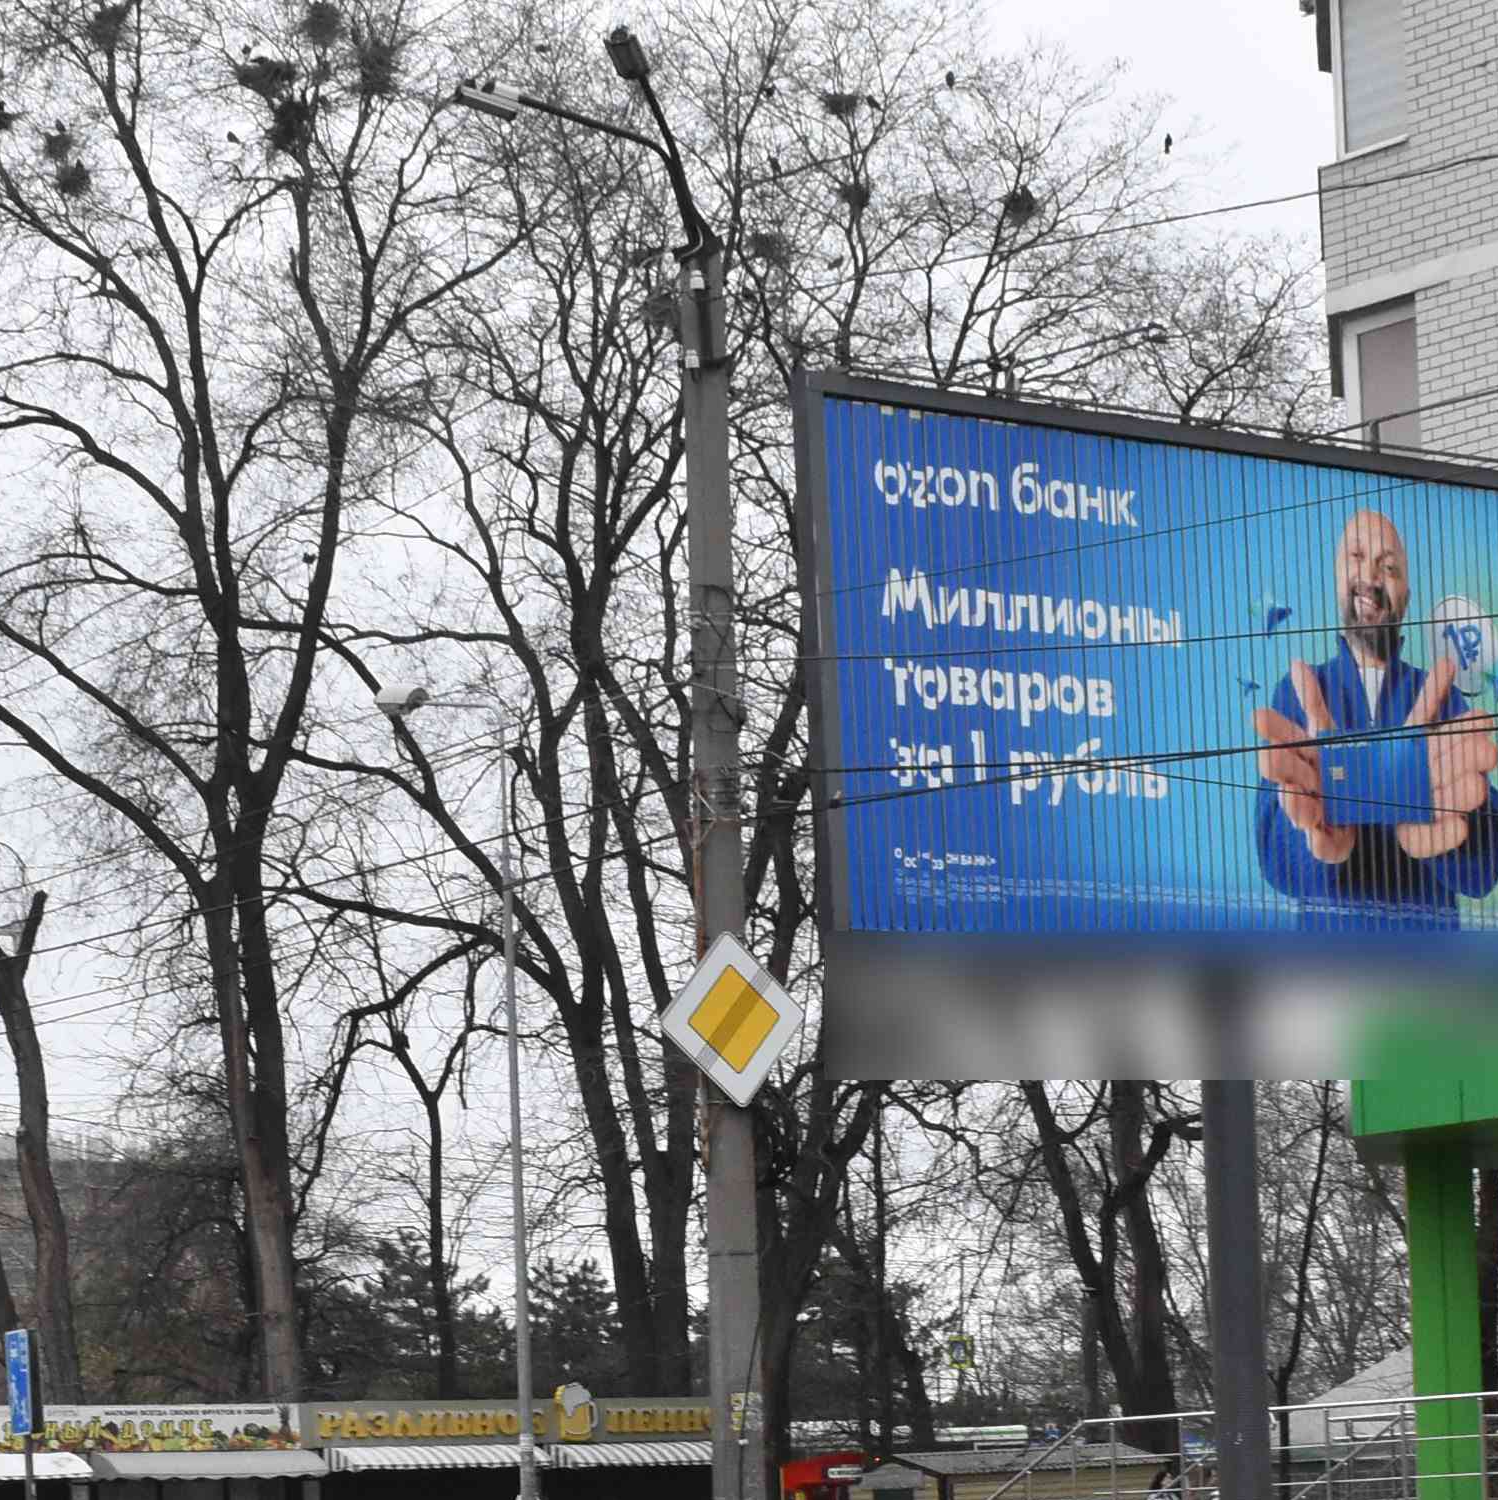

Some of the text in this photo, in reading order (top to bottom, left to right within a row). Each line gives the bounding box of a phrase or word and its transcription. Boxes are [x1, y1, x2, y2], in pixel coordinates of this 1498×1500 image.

[874, 459, 1139, 528] ozon банк
[882, 566, 1182, 648] Миллионы
[884, 657, 1114, 728] товаров
[889, 729, 1169, 807] за 1 рубль
